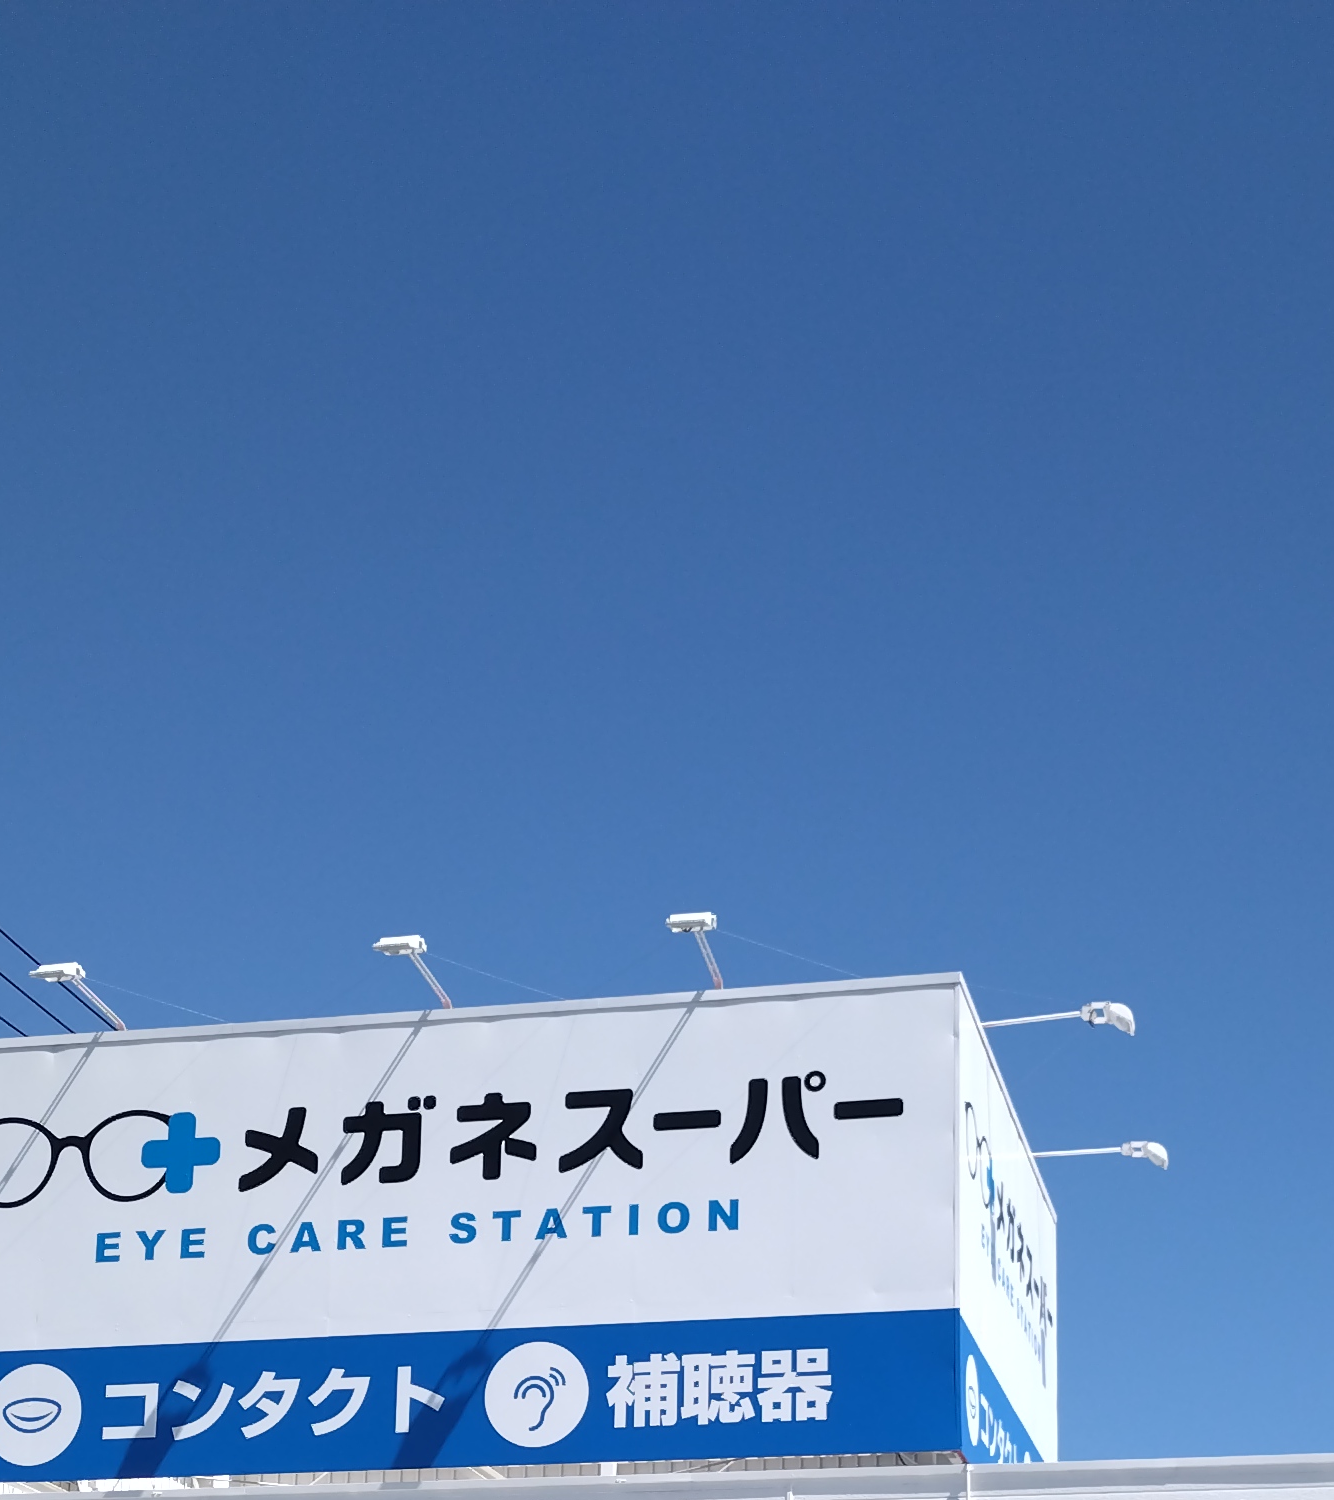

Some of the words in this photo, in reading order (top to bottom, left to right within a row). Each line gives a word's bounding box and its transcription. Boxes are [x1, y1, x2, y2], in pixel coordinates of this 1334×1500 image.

[239, 1071, 903, 1192] メガネスーパー
[95, 1228, 206, 1263] EYE
[247, 1215, 408, 1257] CARE
[449, 1199, 739, 1244] STATION
[996, 1181, 1053, 1338] メガネスーパー
[101, 1365, 445, 1441] コンタクト
[605, 1348, 834, 1428] 補聴器
